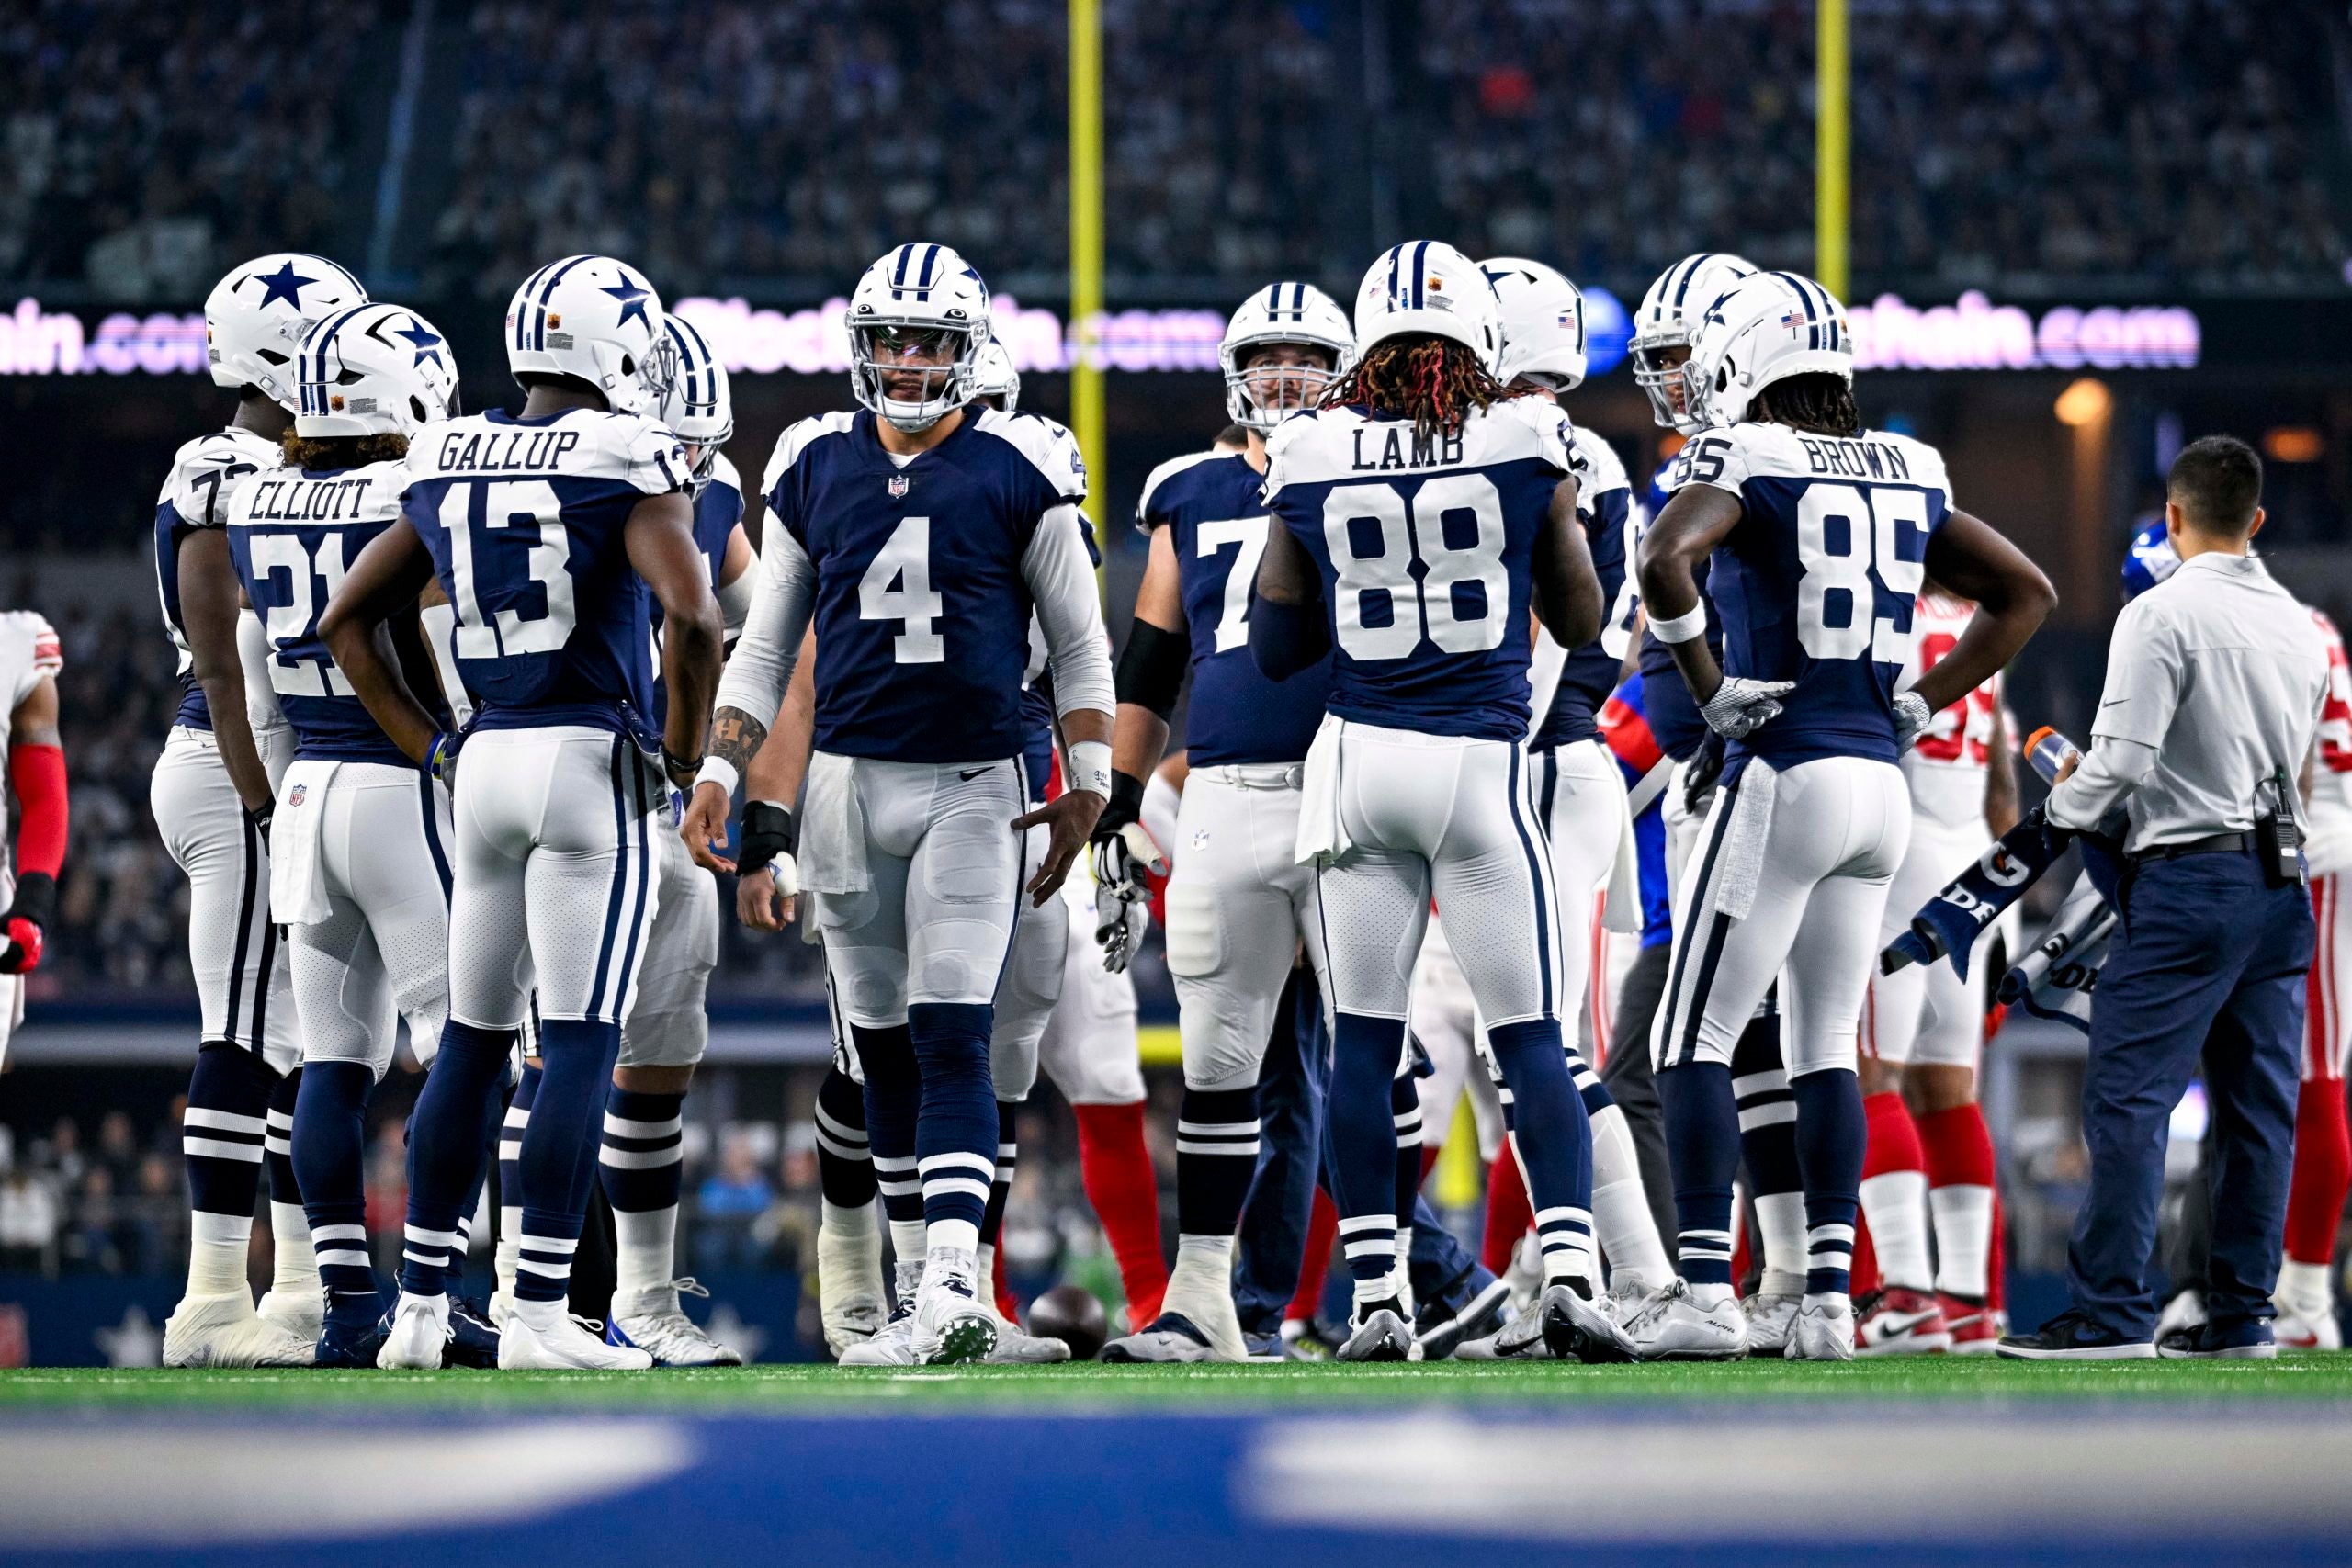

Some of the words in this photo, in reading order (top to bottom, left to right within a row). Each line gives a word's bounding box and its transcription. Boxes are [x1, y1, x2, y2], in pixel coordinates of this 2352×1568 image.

[438, 431, 580, 471] GALLUP
[1351, 423, 1464, 471] LAMB
[1673, 437, 1734, 484] 85
[1797, 437, 1910, 480] BROWN
[248, 478, 372, 520] ELLIOTT
[249, 532, 357, 697] 21
[438, 479, 576, 659] 13
[858, 516, 945, 664] 4
[1323, 473, 1510, 661] 88
[1797, 482, 1930, 665] 85
